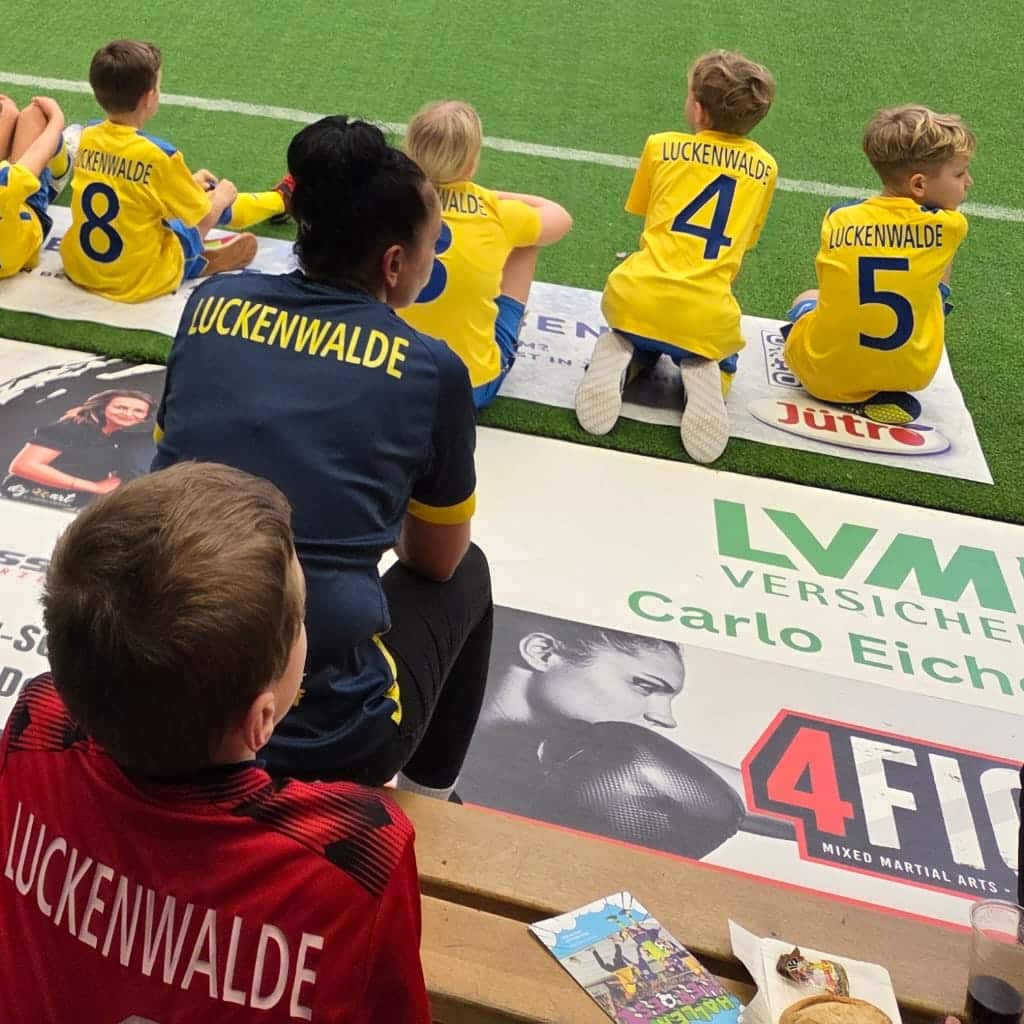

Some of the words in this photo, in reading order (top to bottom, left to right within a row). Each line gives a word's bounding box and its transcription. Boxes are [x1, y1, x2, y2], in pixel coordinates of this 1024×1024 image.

[662, 141, 772, 186] LUCKENWALDE
[79, 181, 124, 264] 8
[670, 173, 738, 261] 4
[828, 224, 944, 250] LUCKENWALDE
[187, 296, 410, 380] LUCKENWALDE
[857, 256, 916, 352] 5
[776, 401, 927, 448] Jütro
[713, 498, 1018, 614] LVM
[627, 589, 823, 654] Carlo
[848, 631, 1024, 697] Eich
[821, 842, 873, 864] MIXED
[879, 855, 952, 883] MARTIAL
[957, 874, 998, 894] ARTS
[4, 801, 325, 1022] LUCKENWALDE
